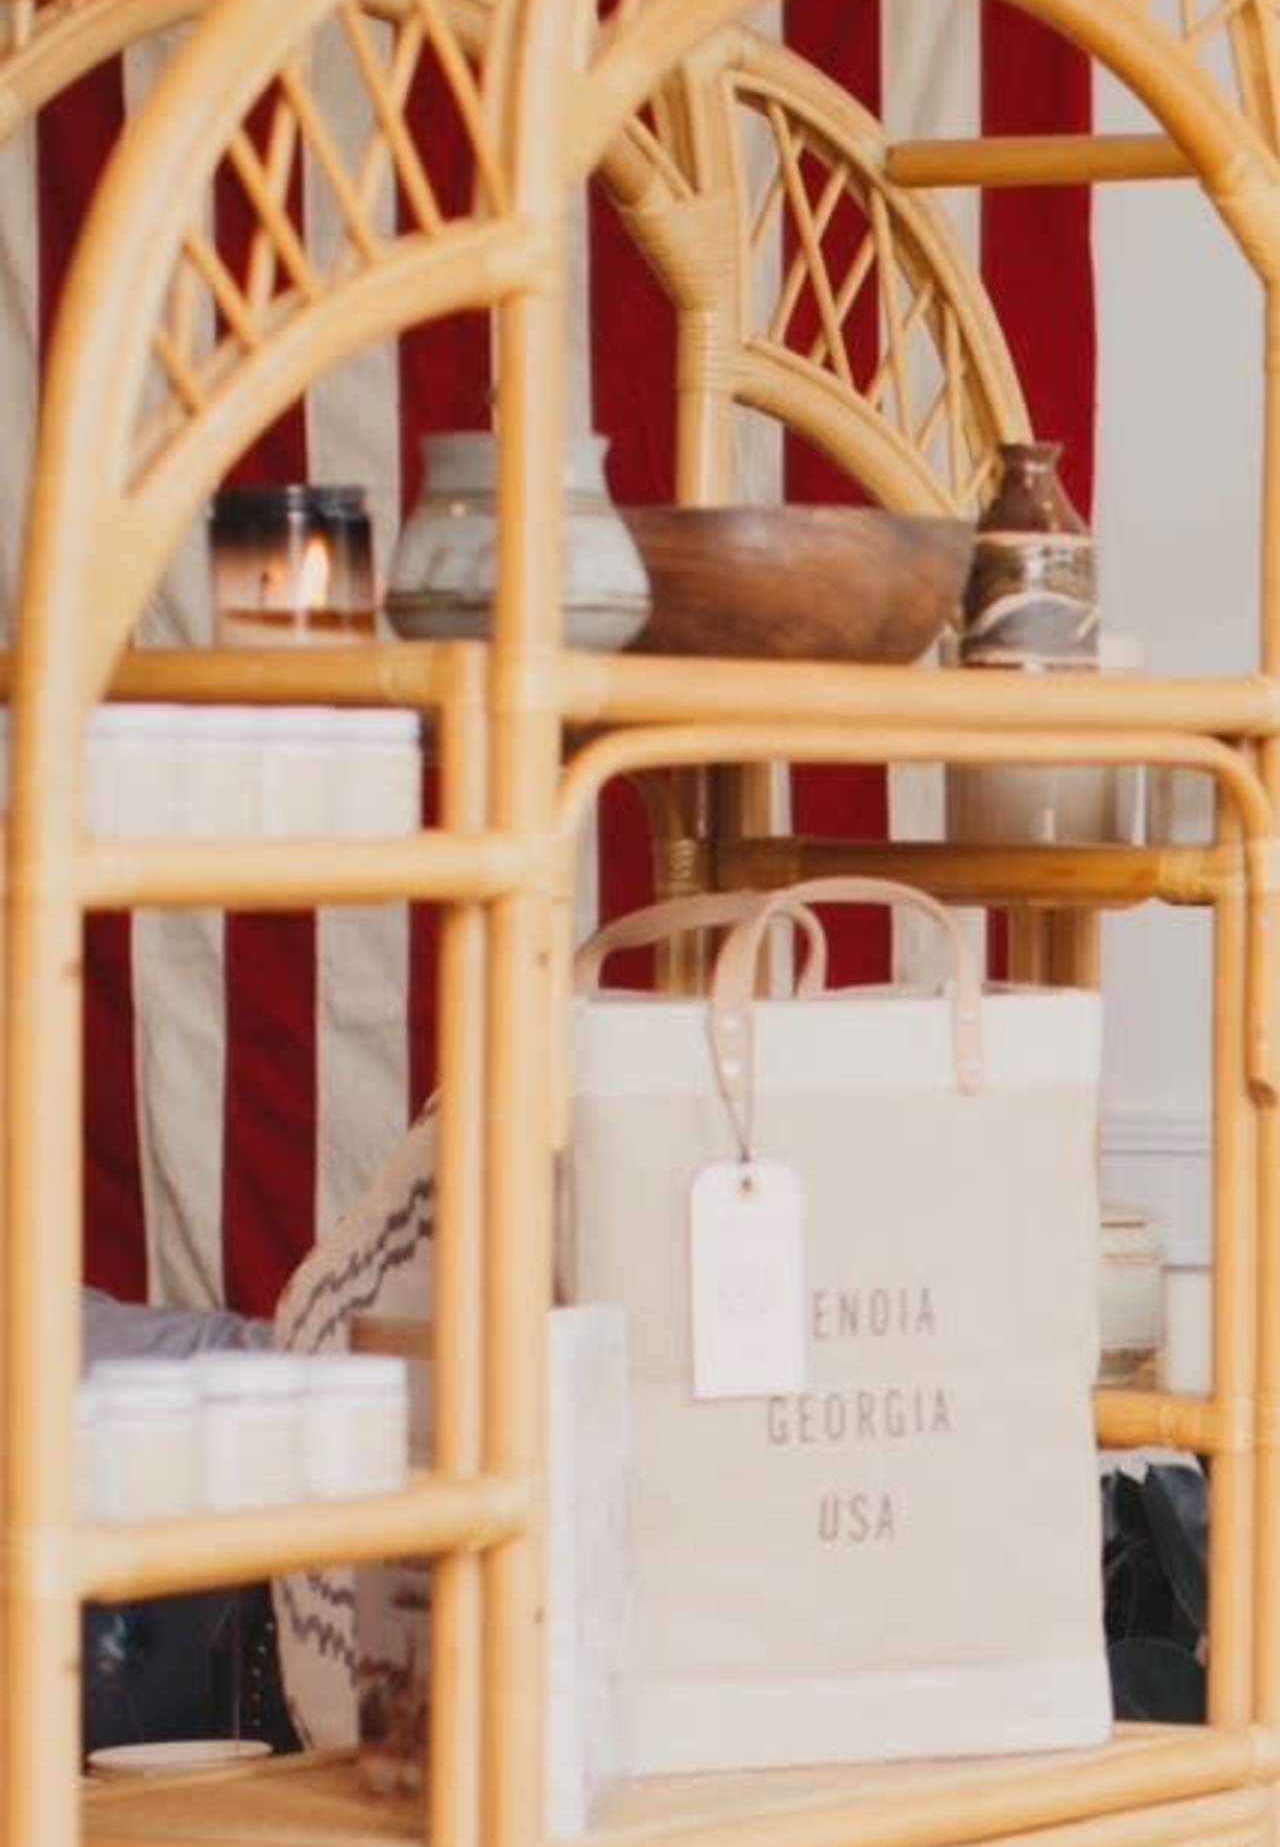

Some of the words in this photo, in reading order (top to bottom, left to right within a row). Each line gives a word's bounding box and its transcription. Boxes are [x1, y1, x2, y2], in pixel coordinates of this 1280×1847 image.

[811, 1286, 936, 1341] ENOIA
[767, 1387, 952, 1445] GEORGIA
[818, 1493, 896, 1542] USA
